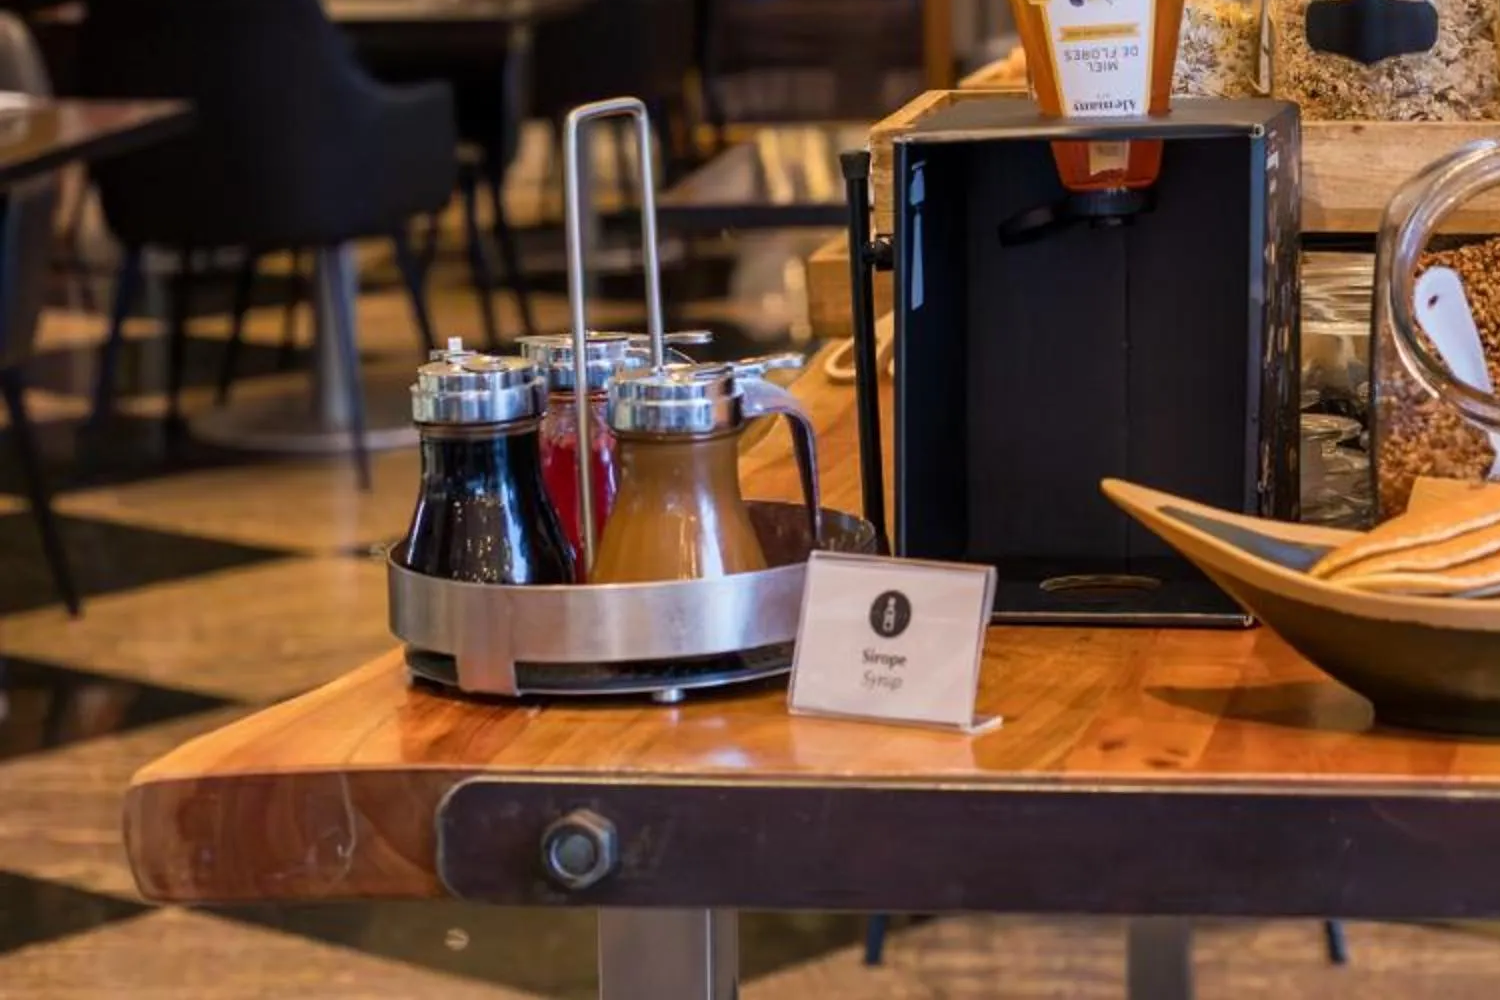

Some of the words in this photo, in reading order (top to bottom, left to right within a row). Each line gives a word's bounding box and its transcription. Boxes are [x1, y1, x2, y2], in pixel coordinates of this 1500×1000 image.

[1064, 48, 1117, 62] FLORES
[1122, 46, 1139, 58] DE
[1087, 61, 1119, 73] MIEL
[1072, 98, 1136, 112] Alemany
[862, 648, 907, 670] Sirope
[861, 671, 904, 690] Syrup
